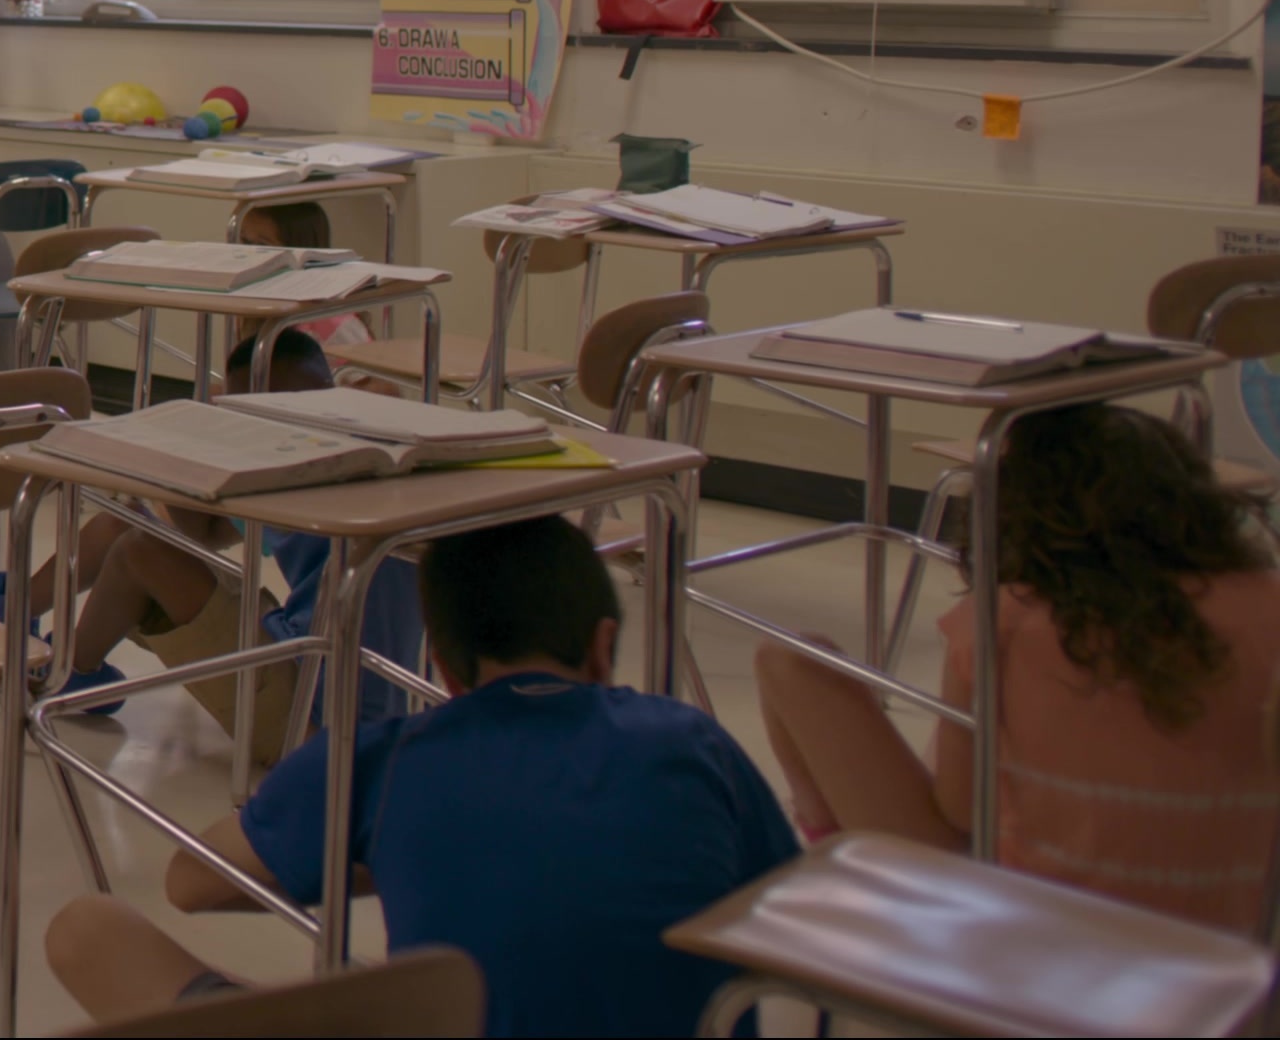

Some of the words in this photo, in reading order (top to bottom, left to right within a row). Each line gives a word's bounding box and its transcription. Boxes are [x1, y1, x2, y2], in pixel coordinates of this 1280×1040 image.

[378, 28, 393, 48] 6.
[398, 28, 447, 48] DRAW
[449, 30, 460, 49] A
[398, 56, 503, 80] CONCLUSION
